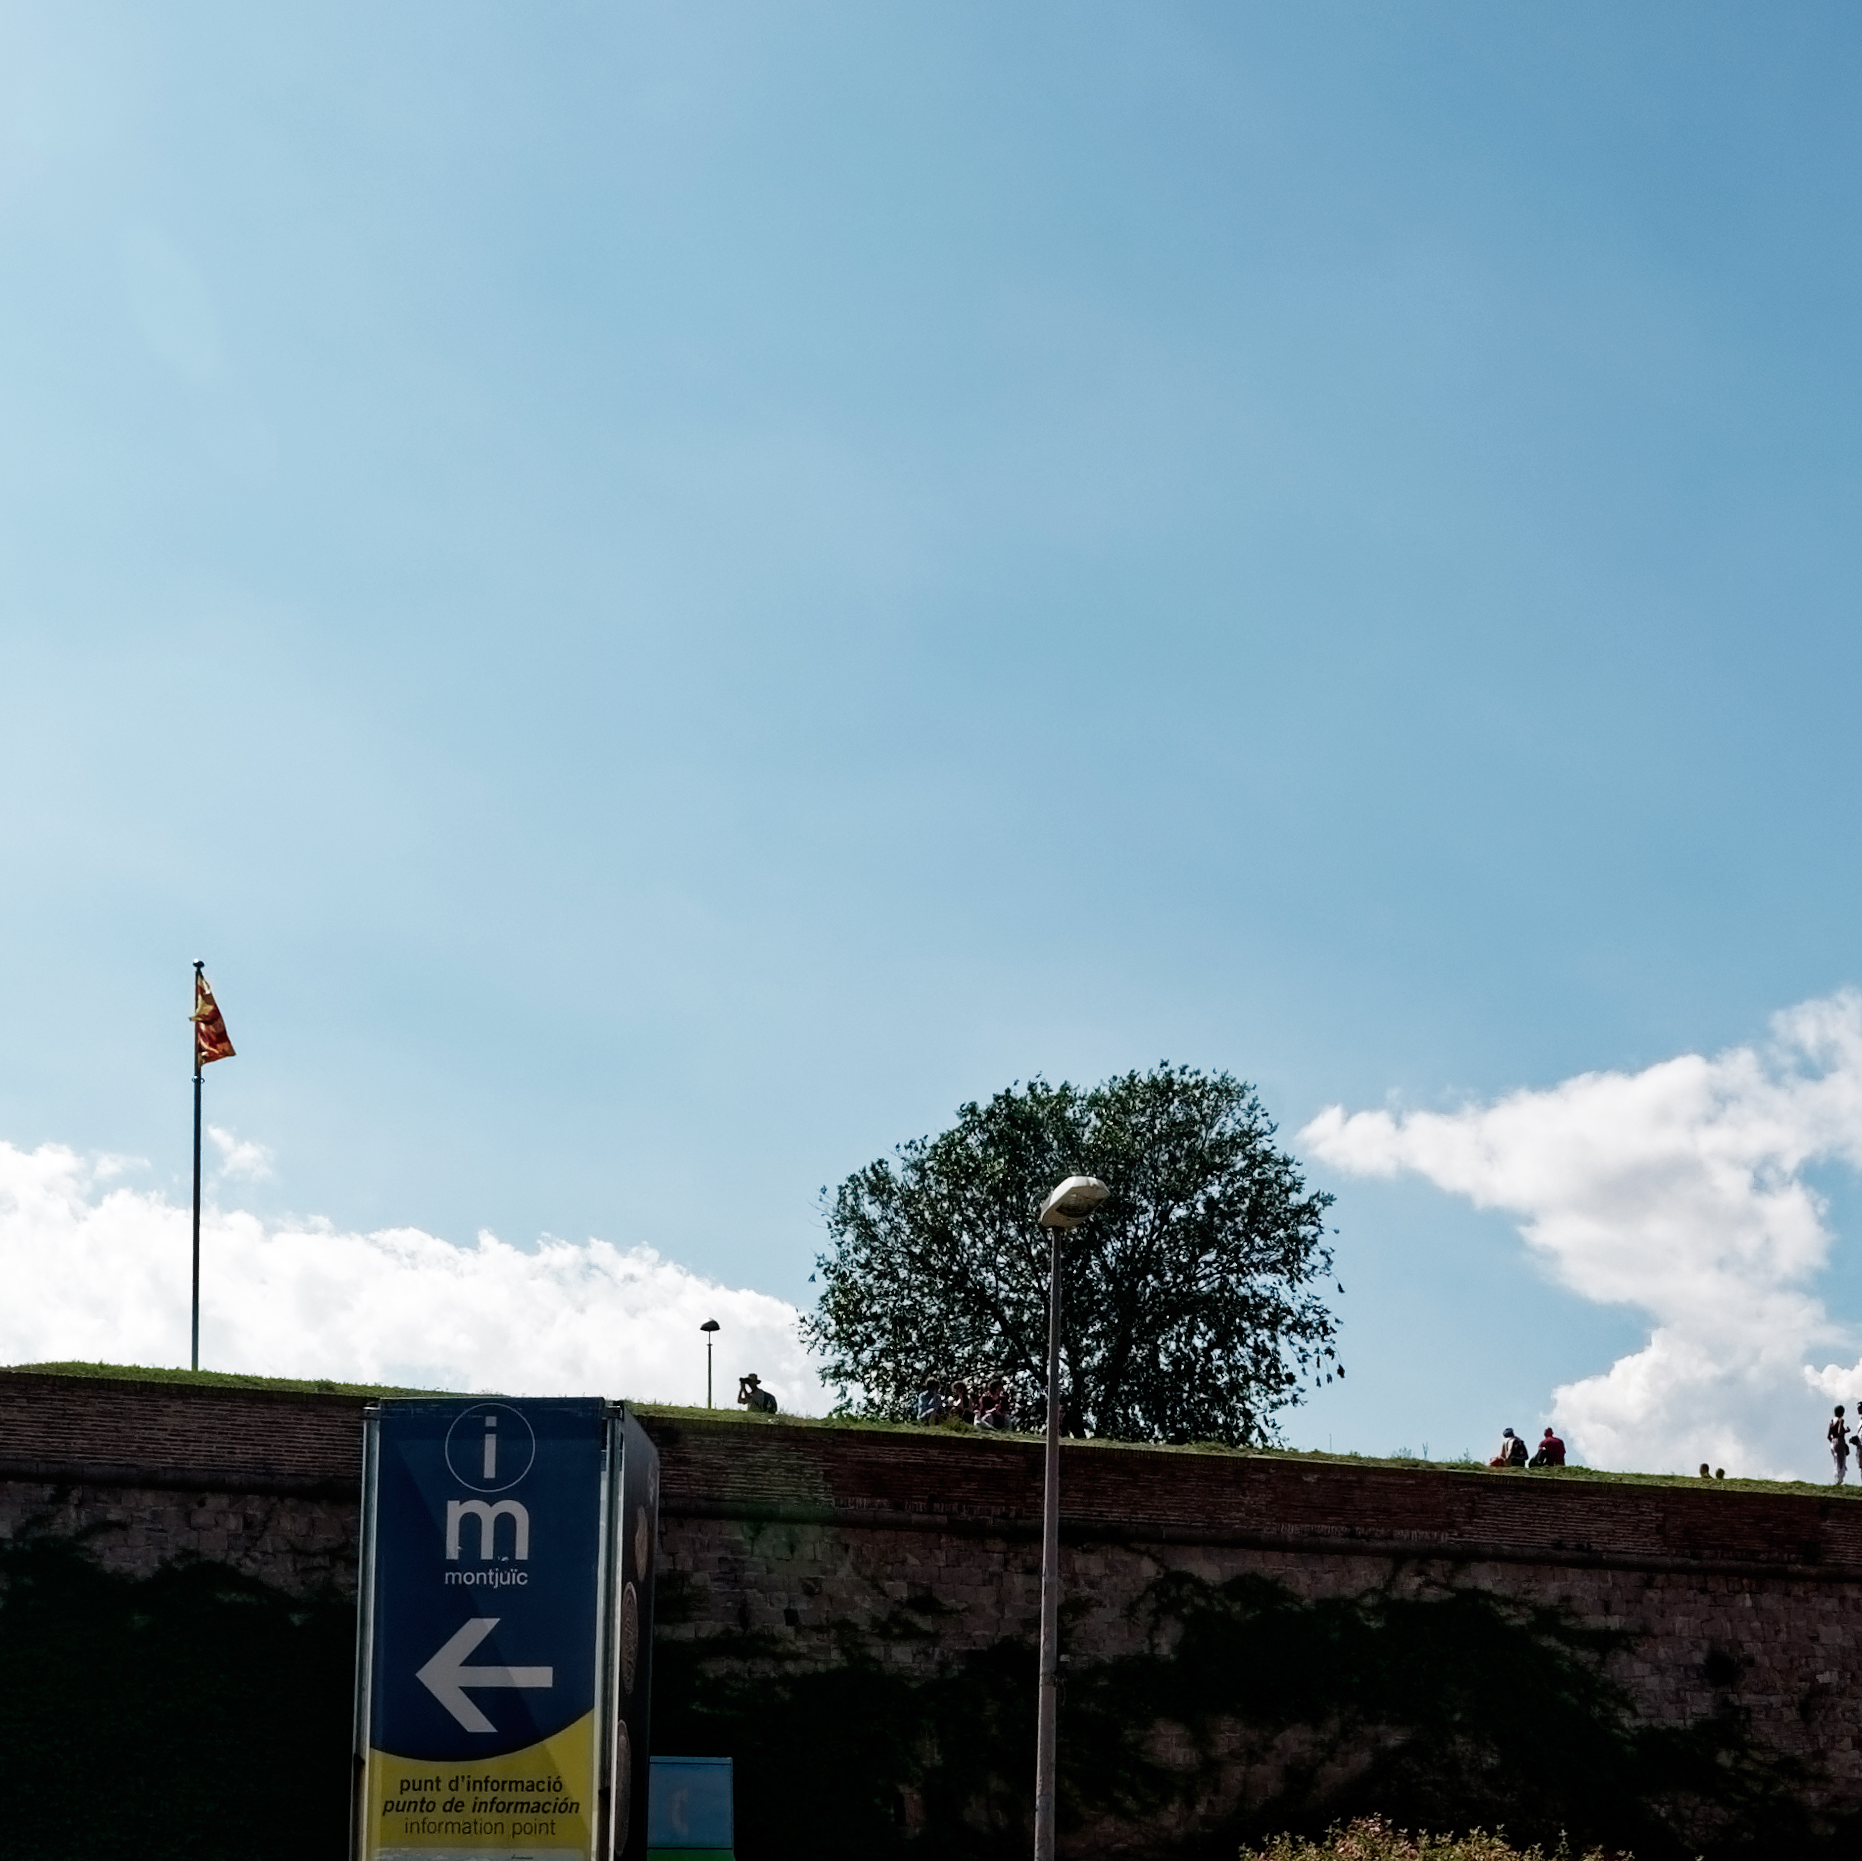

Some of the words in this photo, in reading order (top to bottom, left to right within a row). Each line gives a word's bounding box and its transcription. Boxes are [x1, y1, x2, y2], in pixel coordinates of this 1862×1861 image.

[445, 1568, 528, 1588] montjuïc
[399, 1776, 441, 1795] punt
[449, 1775, 562, 1793] d'informació
[382, 1798, 436, 1816] punto
[443, 1797, 464, 1812] de
[472, 1797, 580, 1814] información
[405, 1818, 504, 1835] information
[512, 1819, 555, 1838] point
